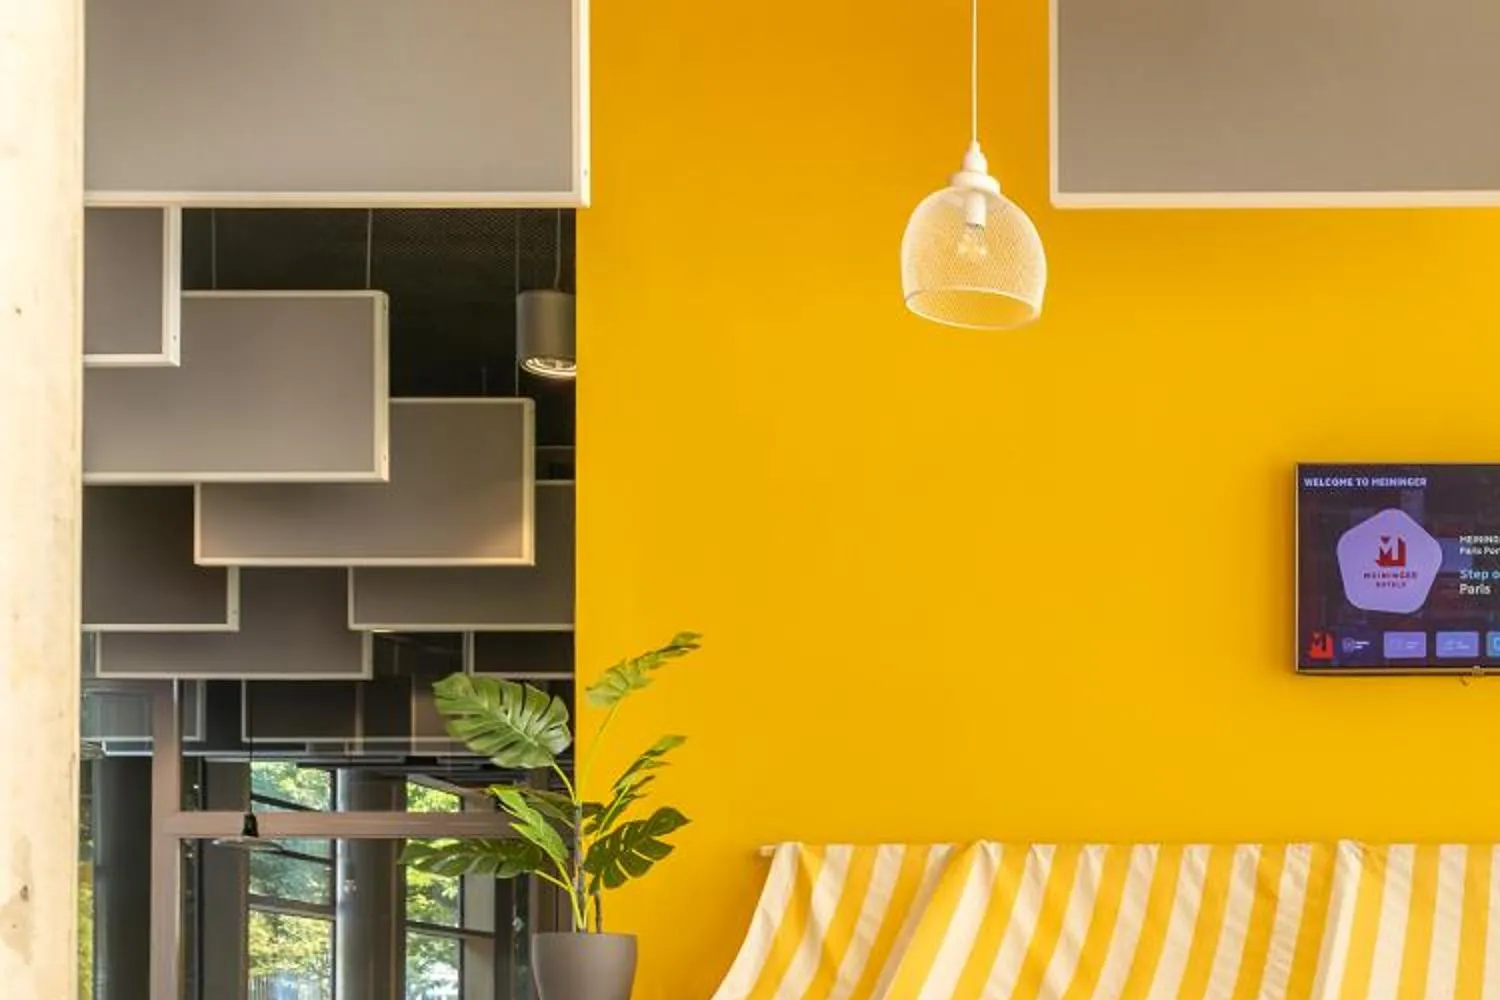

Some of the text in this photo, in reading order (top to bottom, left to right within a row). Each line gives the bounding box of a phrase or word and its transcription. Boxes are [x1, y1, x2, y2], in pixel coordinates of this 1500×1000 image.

[1303, 477, 1427, 487] WELCOME TO MEININGER
[1459, 569, 1489, 581] Step
[1459, 583, 1491, 595] Paris
